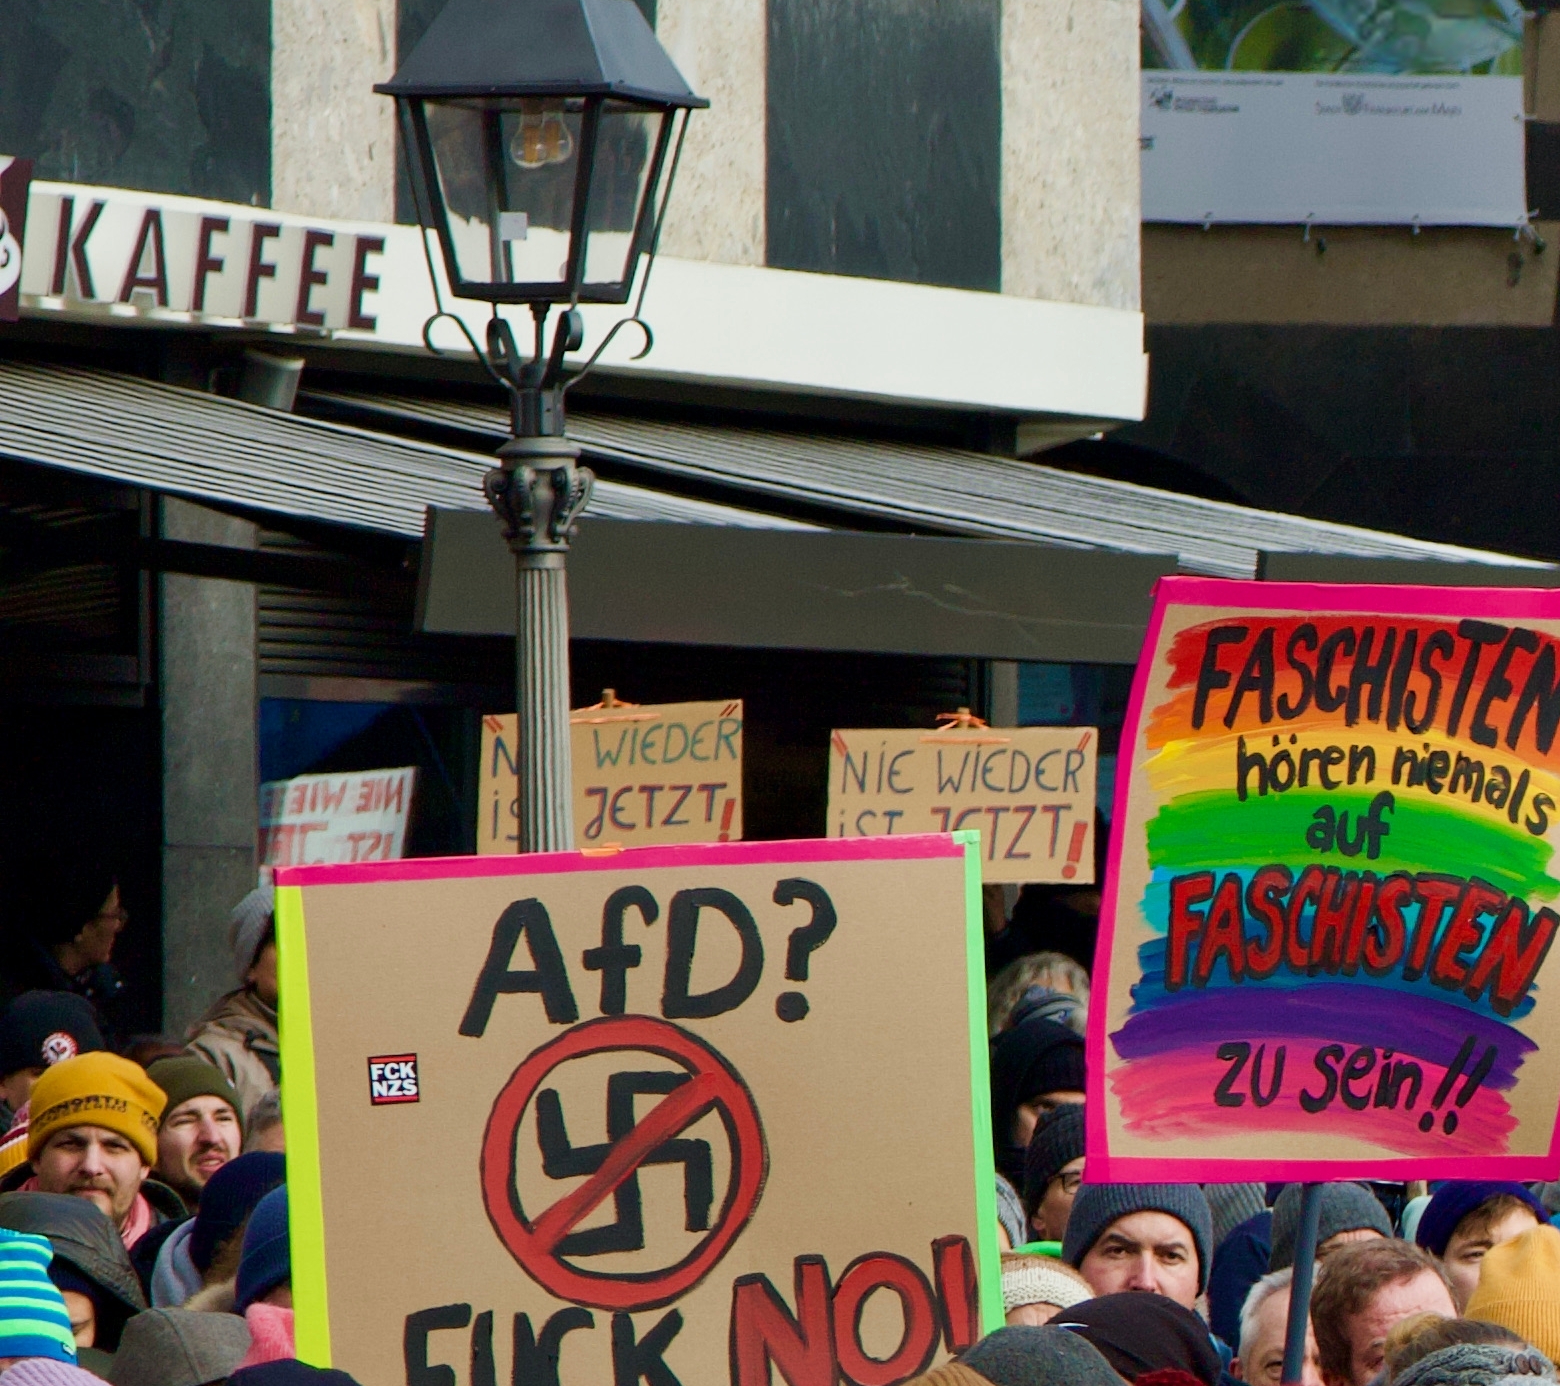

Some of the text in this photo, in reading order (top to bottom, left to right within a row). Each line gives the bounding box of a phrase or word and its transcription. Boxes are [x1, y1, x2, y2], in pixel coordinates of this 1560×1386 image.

[50, 193, 387, 335] KAFFEE
[584, 781, 737, 842] JETZT!
[1235, 733, 1558, 838] hören niemals
[1305, 791, 1396, 860] auf
[457, 876, 838, 1039] AfD?
[370, 1063, 416, 1082] FCK
[371, 1079, 418, 1098] NZS
